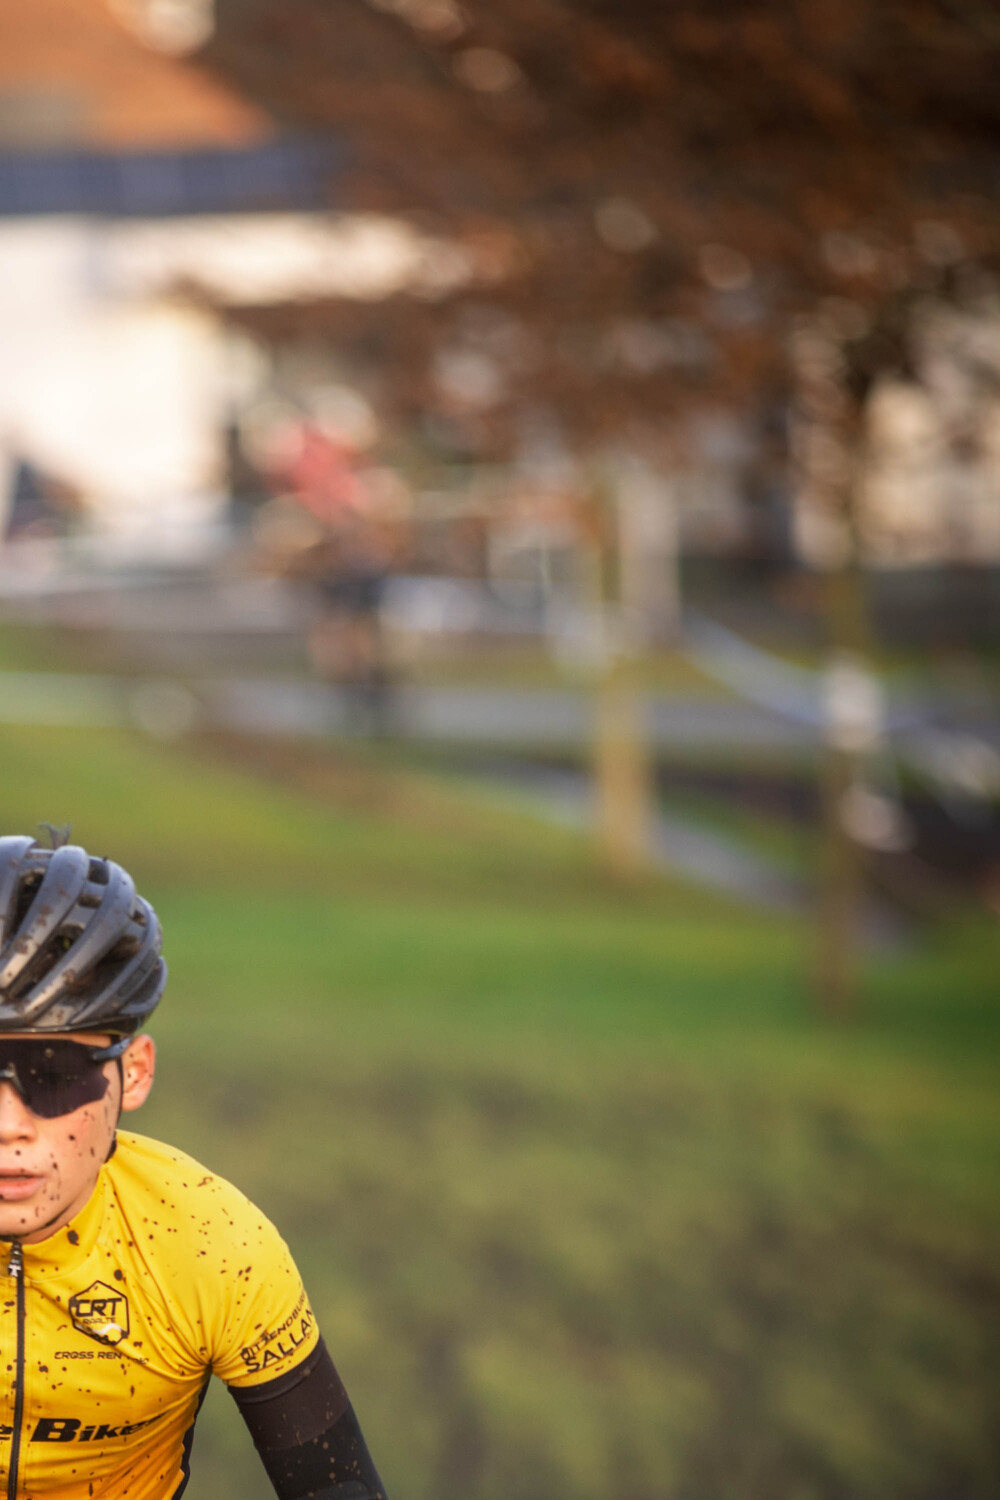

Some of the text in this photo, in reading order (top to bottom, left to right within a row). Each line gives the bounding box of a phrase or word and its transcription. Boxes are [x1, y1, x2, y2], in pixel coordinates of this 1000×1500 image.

[75, 1297, 122, 1317] CRT
[245, 1309, 312, 1373] SALLAN
[54, 1351, 95, 1360] CROSS
[28, 1417, 156, 1442] Bike
